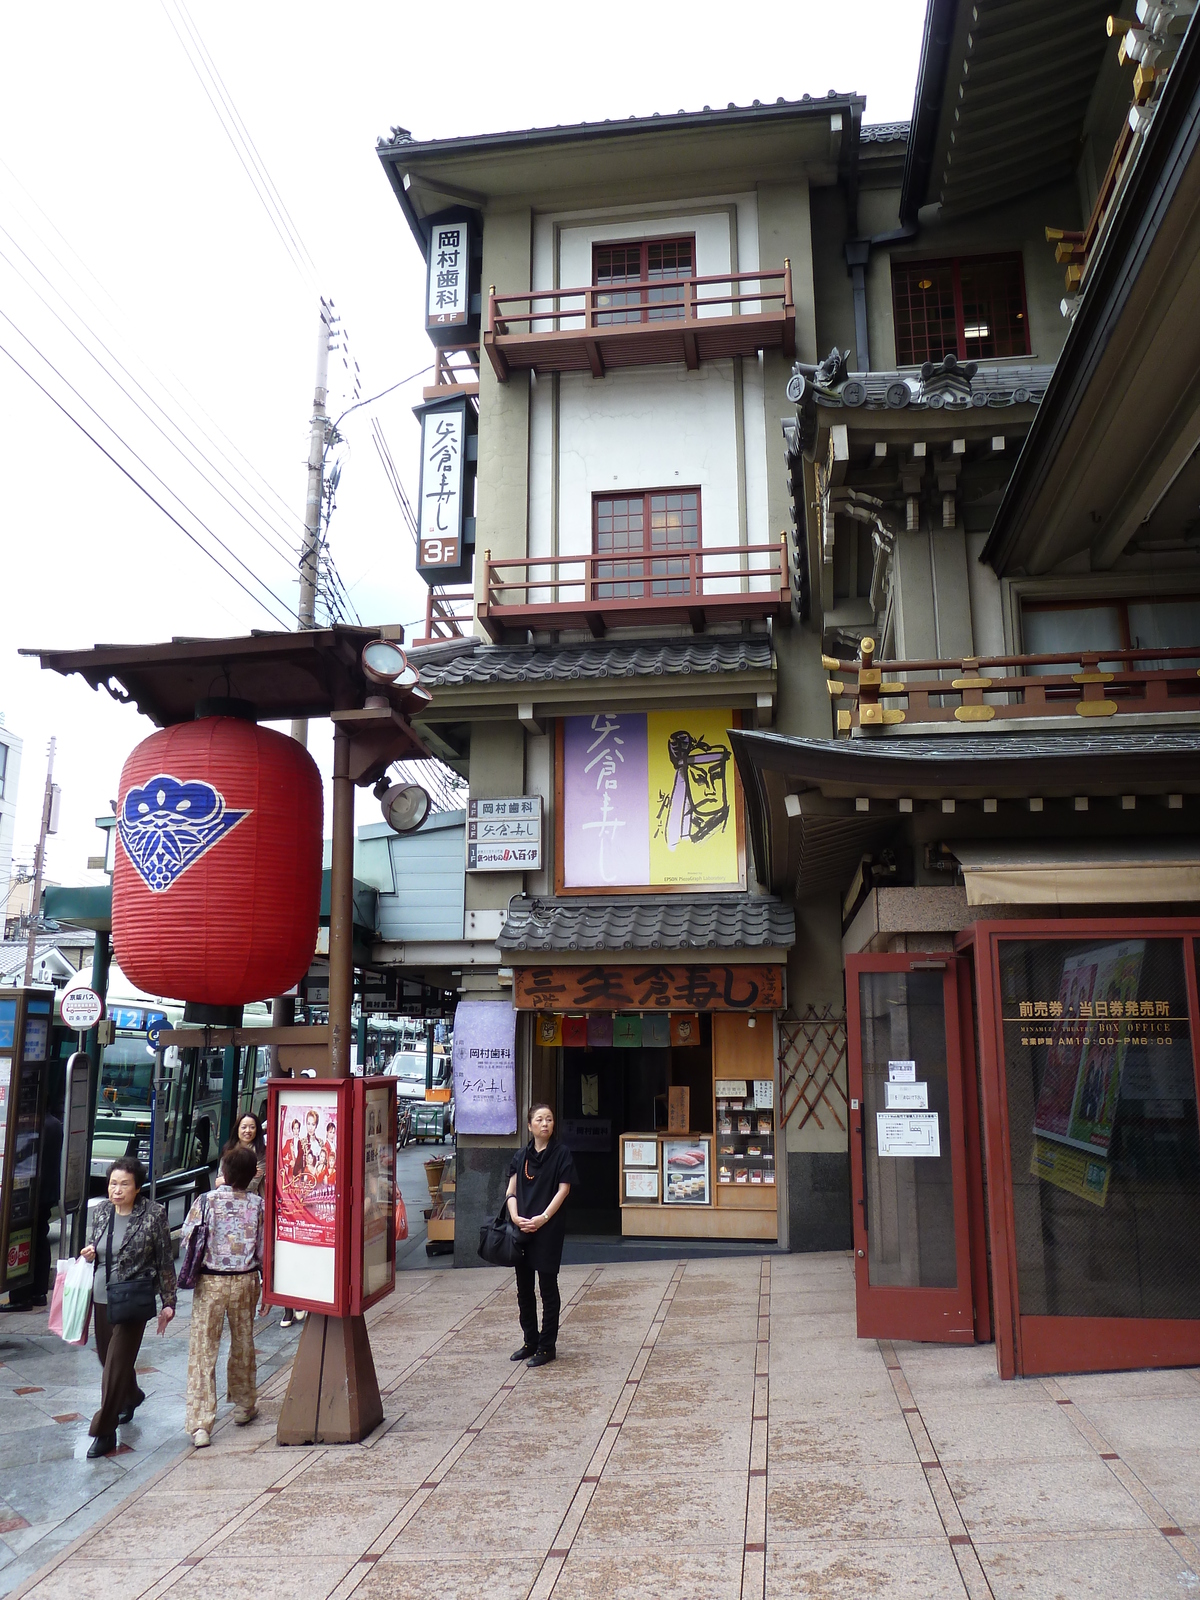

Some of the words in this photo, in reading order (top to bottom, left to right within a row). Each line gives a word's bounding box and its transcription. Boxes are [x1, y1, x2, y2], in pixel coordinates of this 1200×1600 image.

[436, 230, 460, 309] 岡村歯科
[436, 313, 457, 323] 4F
[426, 420, 457, 531] 矢倉寿し
[423, 540, 455, 564] 3F
[582, 713, 626, 883] 矢倉寿し
[471, 803, 477, 816] 4F
[483, 802, 533, 814] 岡村歯科
[470, 825, 476, 838] 3F
[482, 823, 534, 837] 矢倉寿し
[470, 850, 476, 863] 1F
[509, 849, 537, 861] 八百伊
[573, 967, 759, 1008] 矢倉寿し
[1019, 1001, 1170, 1017] 前売券・当日券発売所
[1099, 1024, 1120, 1032] BOX
[1127, 1023, 1171, 1032] OFFICE
[1021, 1038, 1053, 1046] 営業時間
[469, 1048, 511, 1059] 岡村歯科
[462, 1078, 507, 1094] 矢倉寿し
[576, 1127, 608, 1135] 岡村歯科
